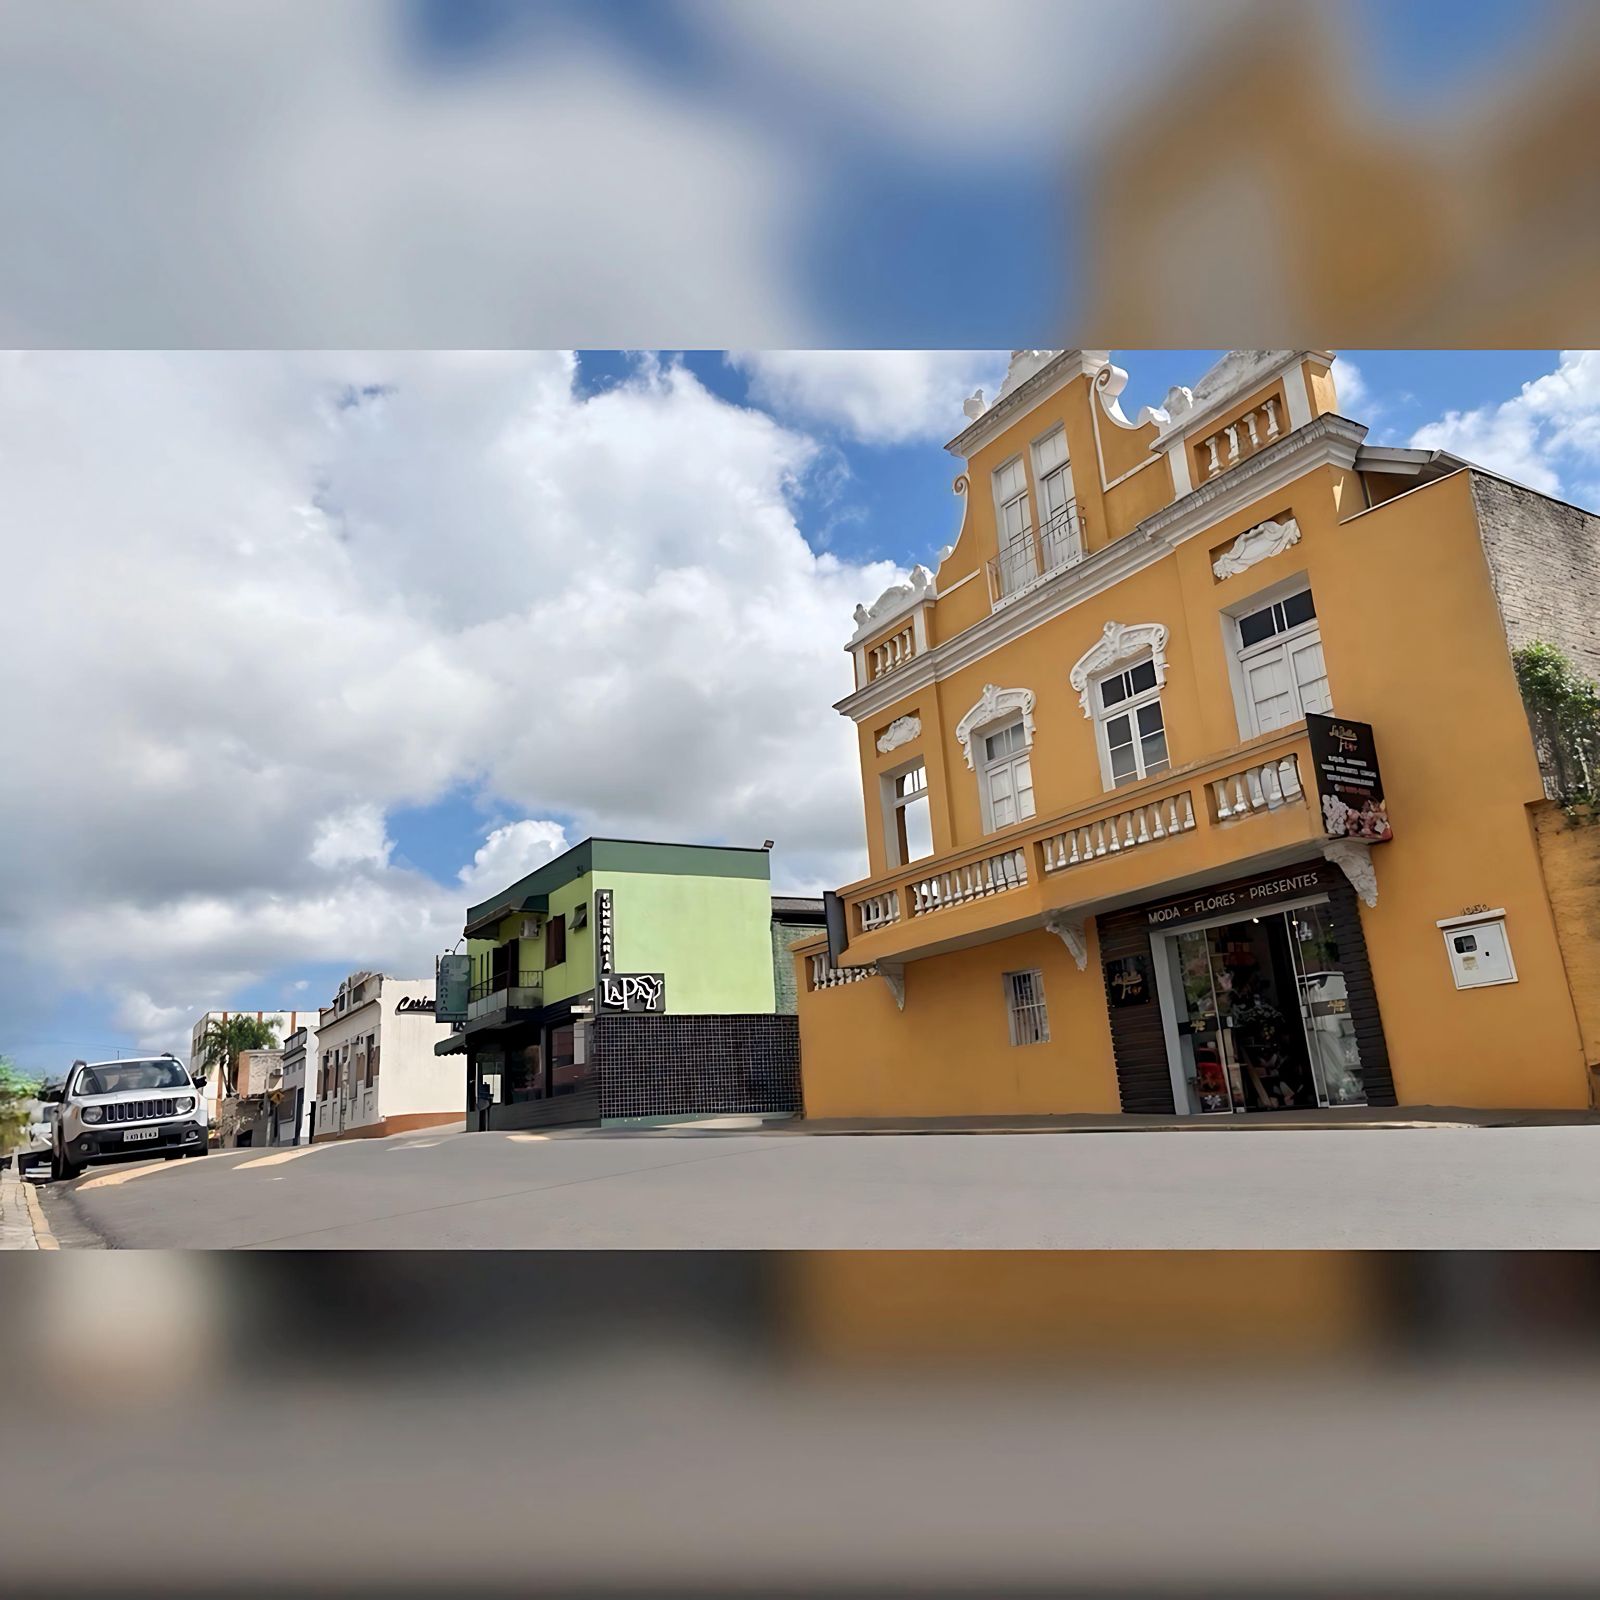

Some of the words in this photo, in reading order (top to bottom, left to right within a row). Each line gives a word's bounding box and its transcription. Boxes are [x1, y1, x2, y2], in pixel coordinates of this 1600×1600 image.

[1148, 908, 1181, 924] MODA
[1194, 893, 1236, 913] FLORES
[1249, 872, 1319, 899] PRESENTES
